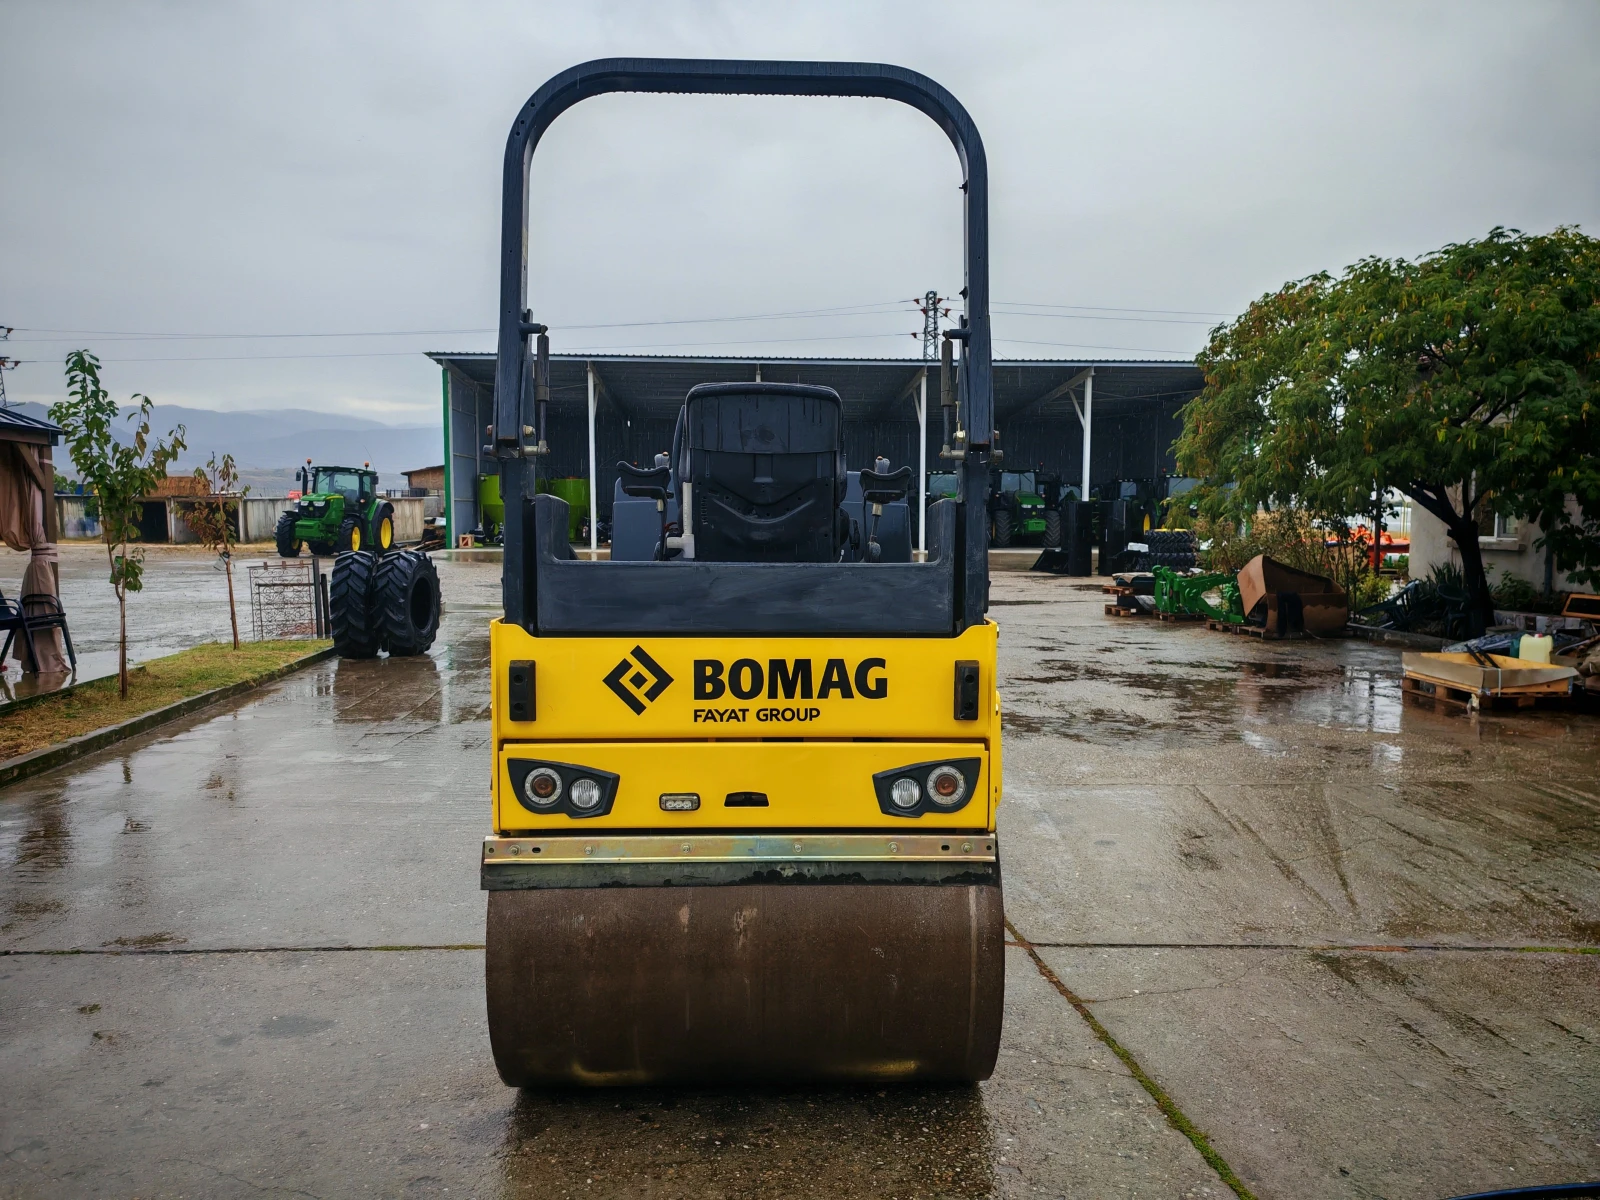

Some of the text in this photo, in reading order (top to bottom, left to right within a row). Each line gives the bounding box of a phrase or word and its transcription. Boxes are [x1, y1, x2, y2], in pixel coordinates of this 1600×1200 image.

[693, 658, 888, 701] BOMAG
[693, 707, 821, 723] FAYAT GROUP
